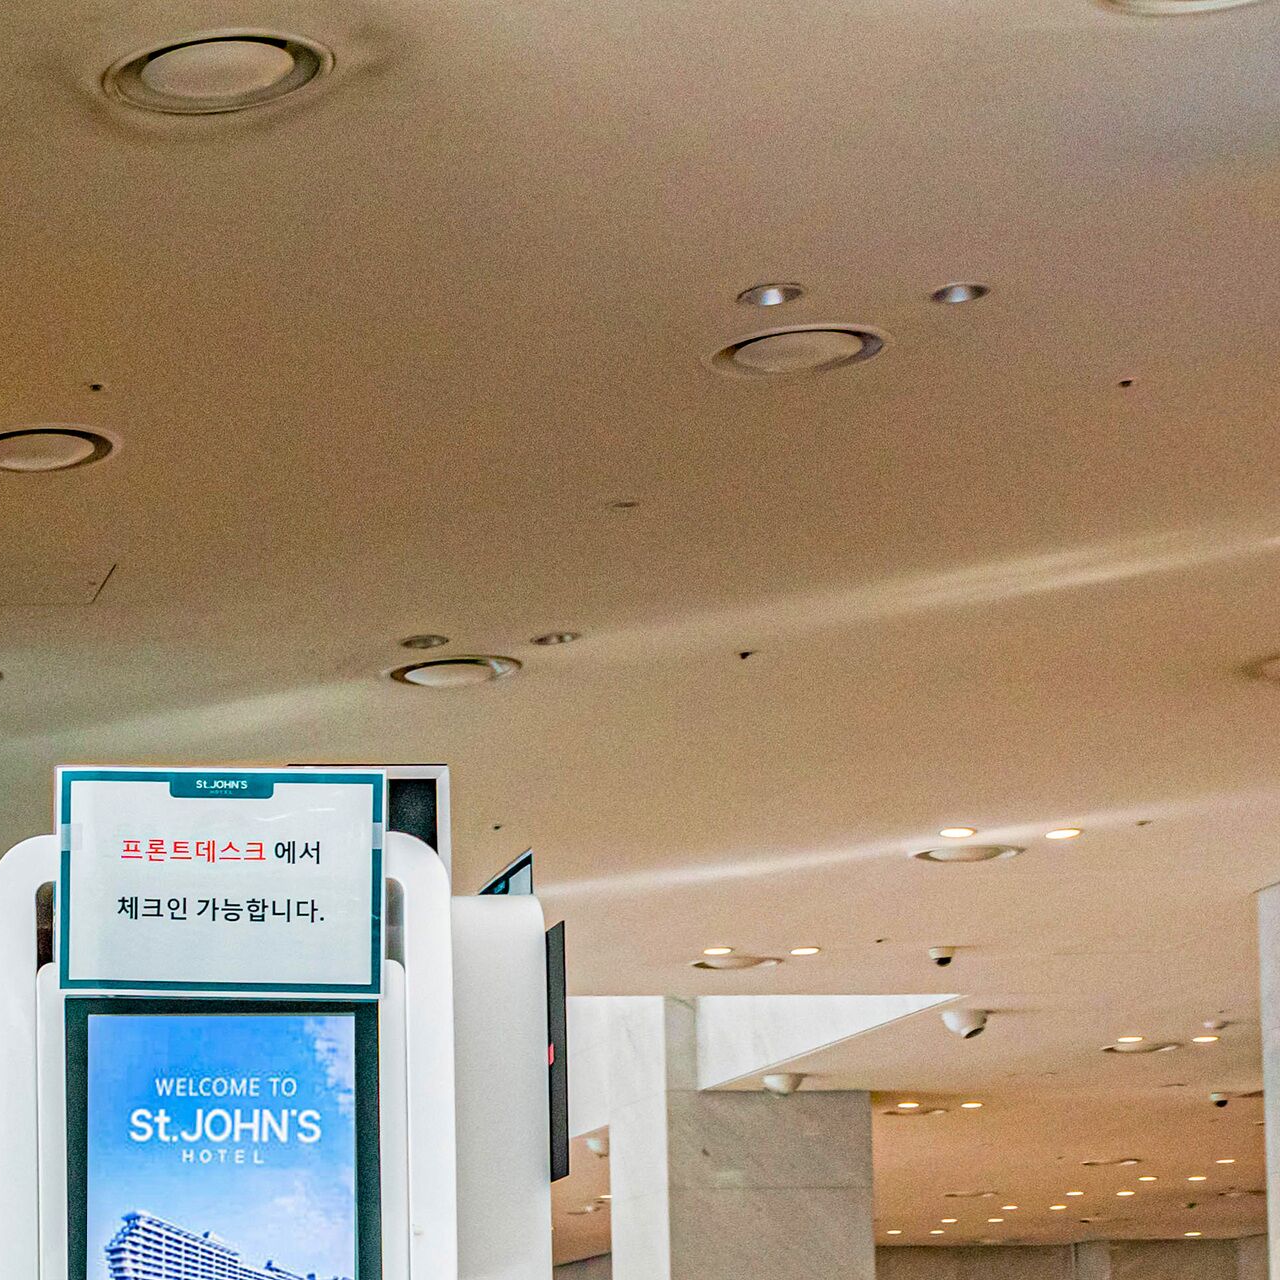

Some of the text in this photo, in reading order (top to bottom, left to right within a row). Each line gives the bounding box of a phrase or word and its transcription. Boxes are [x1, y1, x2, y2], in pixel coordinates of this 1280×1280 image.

[121, 840, 321, 865] 프론트데스크 에서
[117, 896, 325, 922] 체크인 가능합니다.
[155, 1077, 297, 1097] WELCOME TO
[129, 1108, 322, 1143] St.JOHN'S
[182, 1149, 265, 1164] HOTEL
